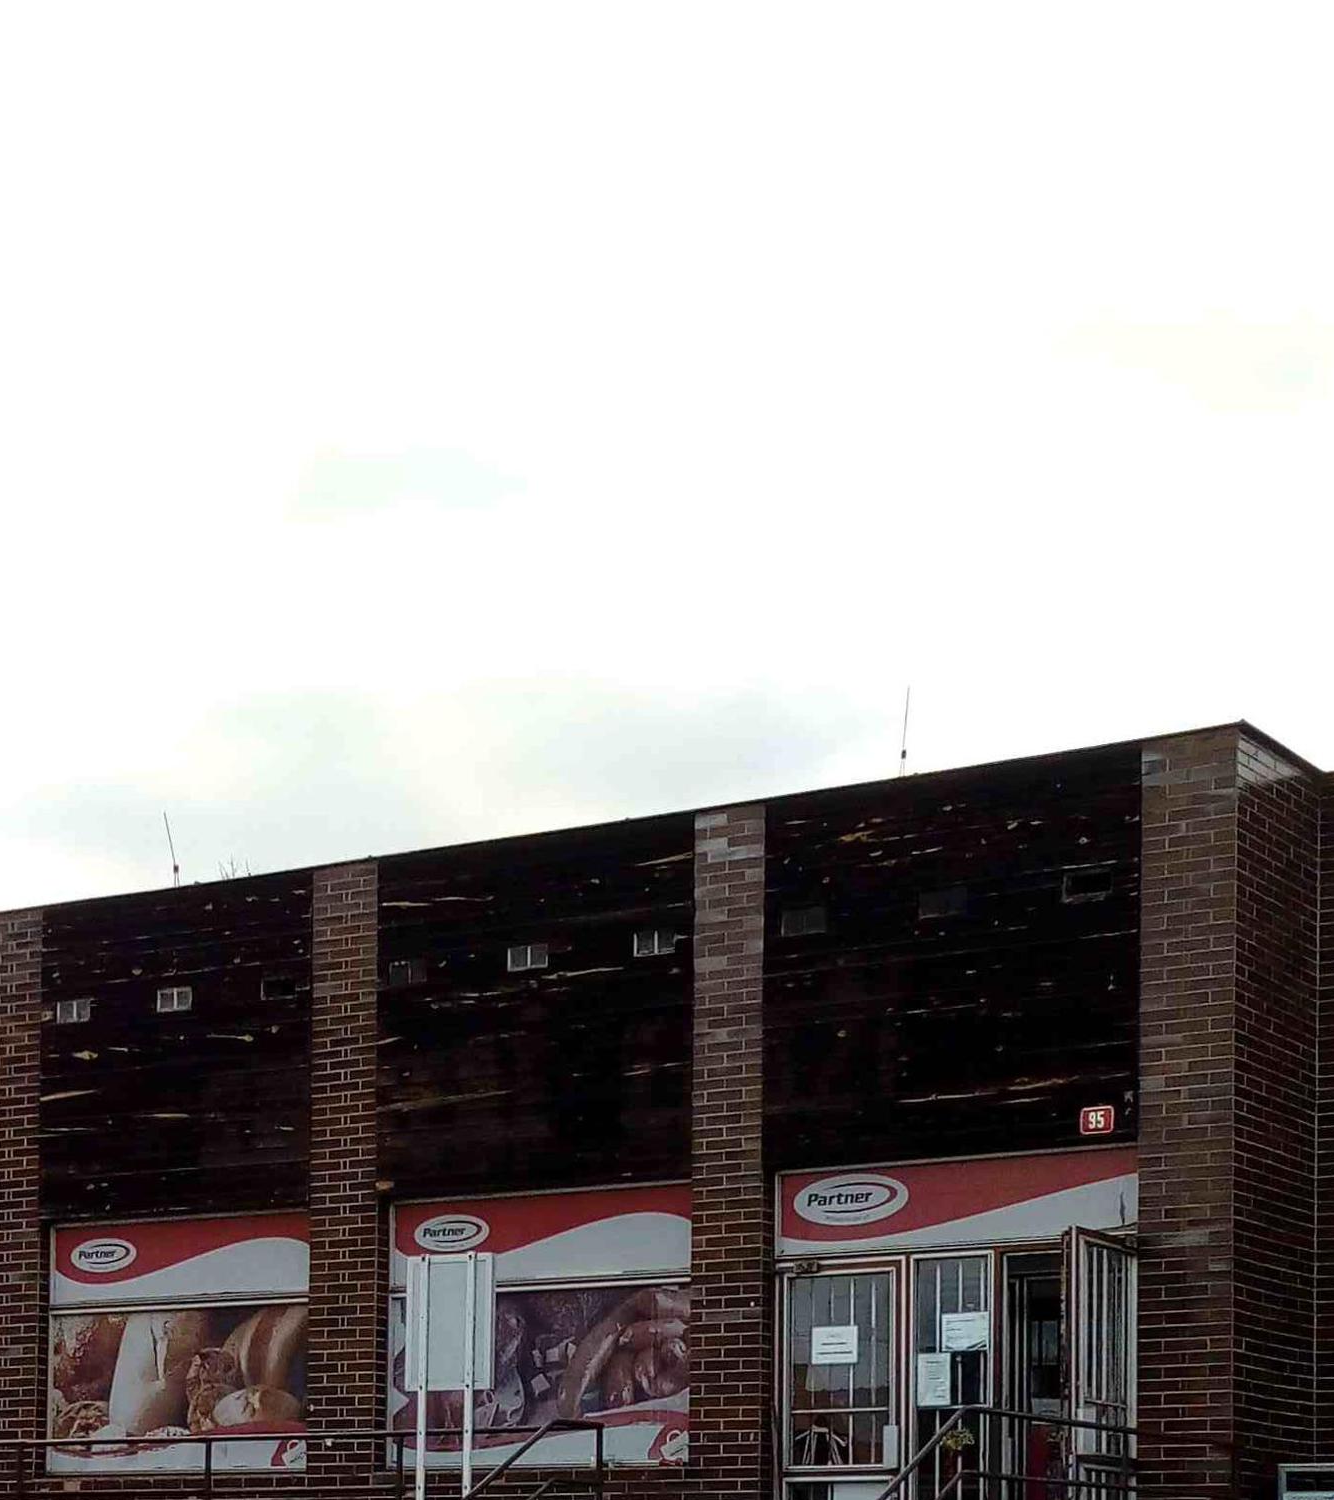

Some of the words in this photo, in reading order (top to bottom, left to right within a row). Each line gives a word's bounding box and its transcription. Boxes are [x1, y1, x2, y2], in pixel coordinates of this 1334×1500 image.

[1088, 1111, 1105, 1129] 95
[806, 1192, 873, 1207] Partner
[423, 1227, 466, 1238] Partner
[78, 1250, 116, 1260] Partner
